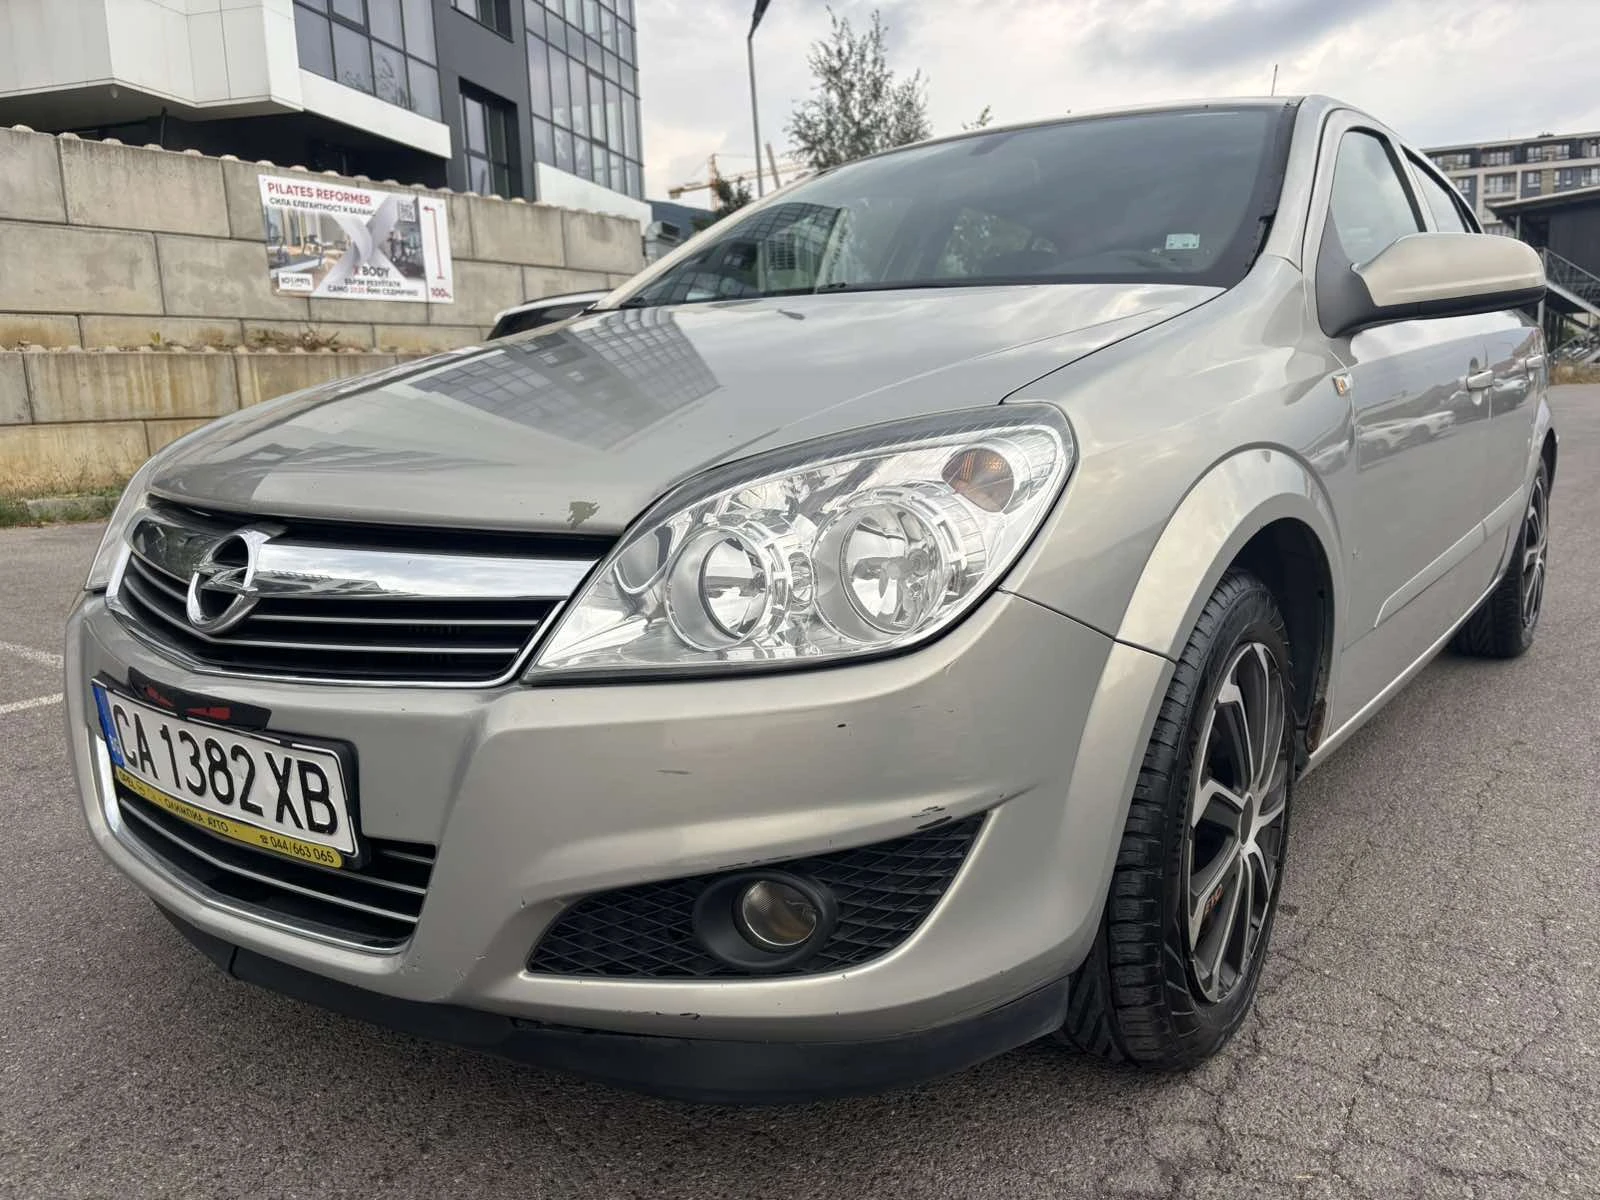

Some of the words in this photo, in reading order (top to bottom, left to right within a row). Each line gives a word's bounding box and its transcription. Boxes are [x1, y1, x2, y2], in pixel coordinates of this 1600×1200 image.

[267, 183, 314, 198] PILATES
[316, 188, 371, 205] REFORMER
[269, 197, 291, 206] СИЛА
[362, 266, 390, 277] BODY
[312, 847, 335, 863] 065
